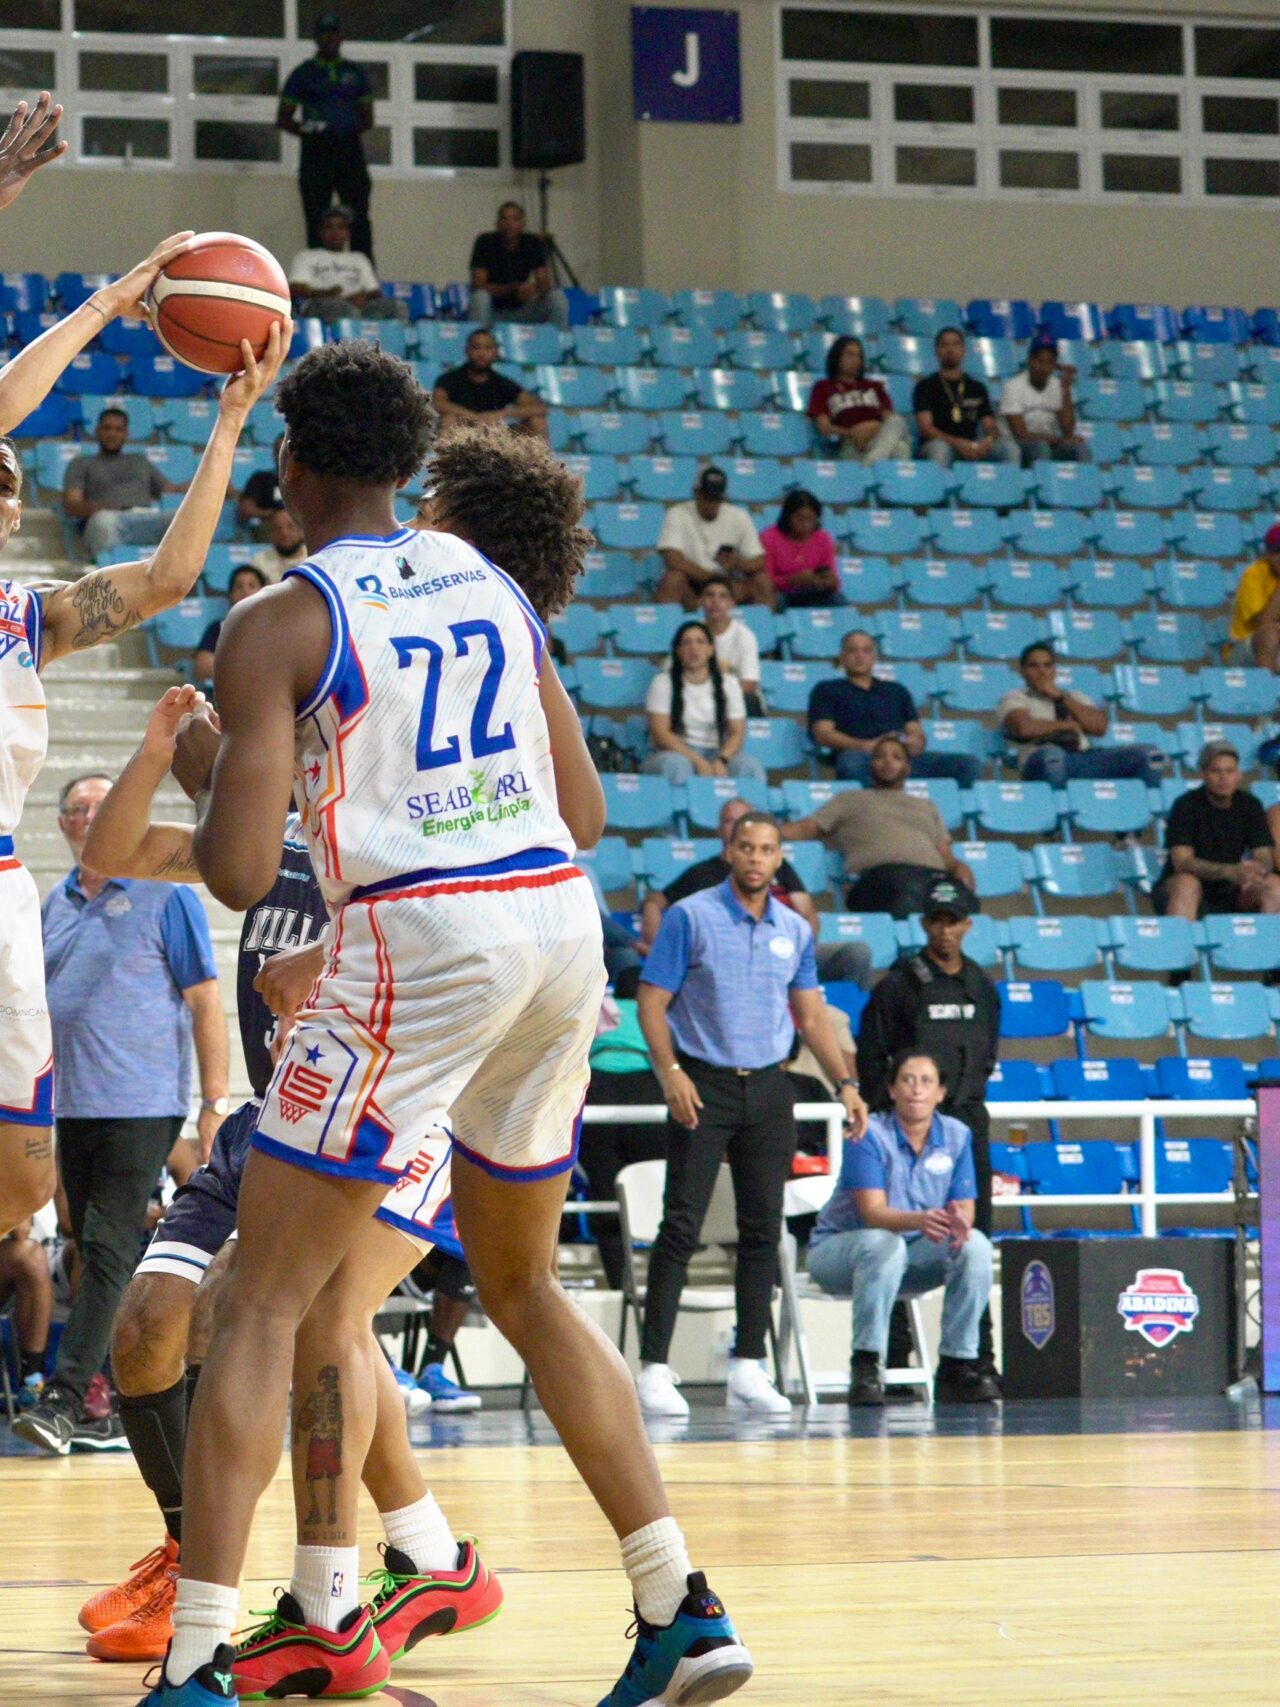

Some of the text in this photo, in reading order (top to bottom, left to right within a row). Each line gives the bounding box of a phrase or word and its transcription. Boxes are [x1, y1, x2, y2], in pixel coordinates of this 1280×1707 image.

[669, 31, 700, 88] J
[388, 569, 487, 600] BANRESERVAS
[388, 618, 517, 772] 22
[1120, 1295, 1195, 1313] ABADINA
